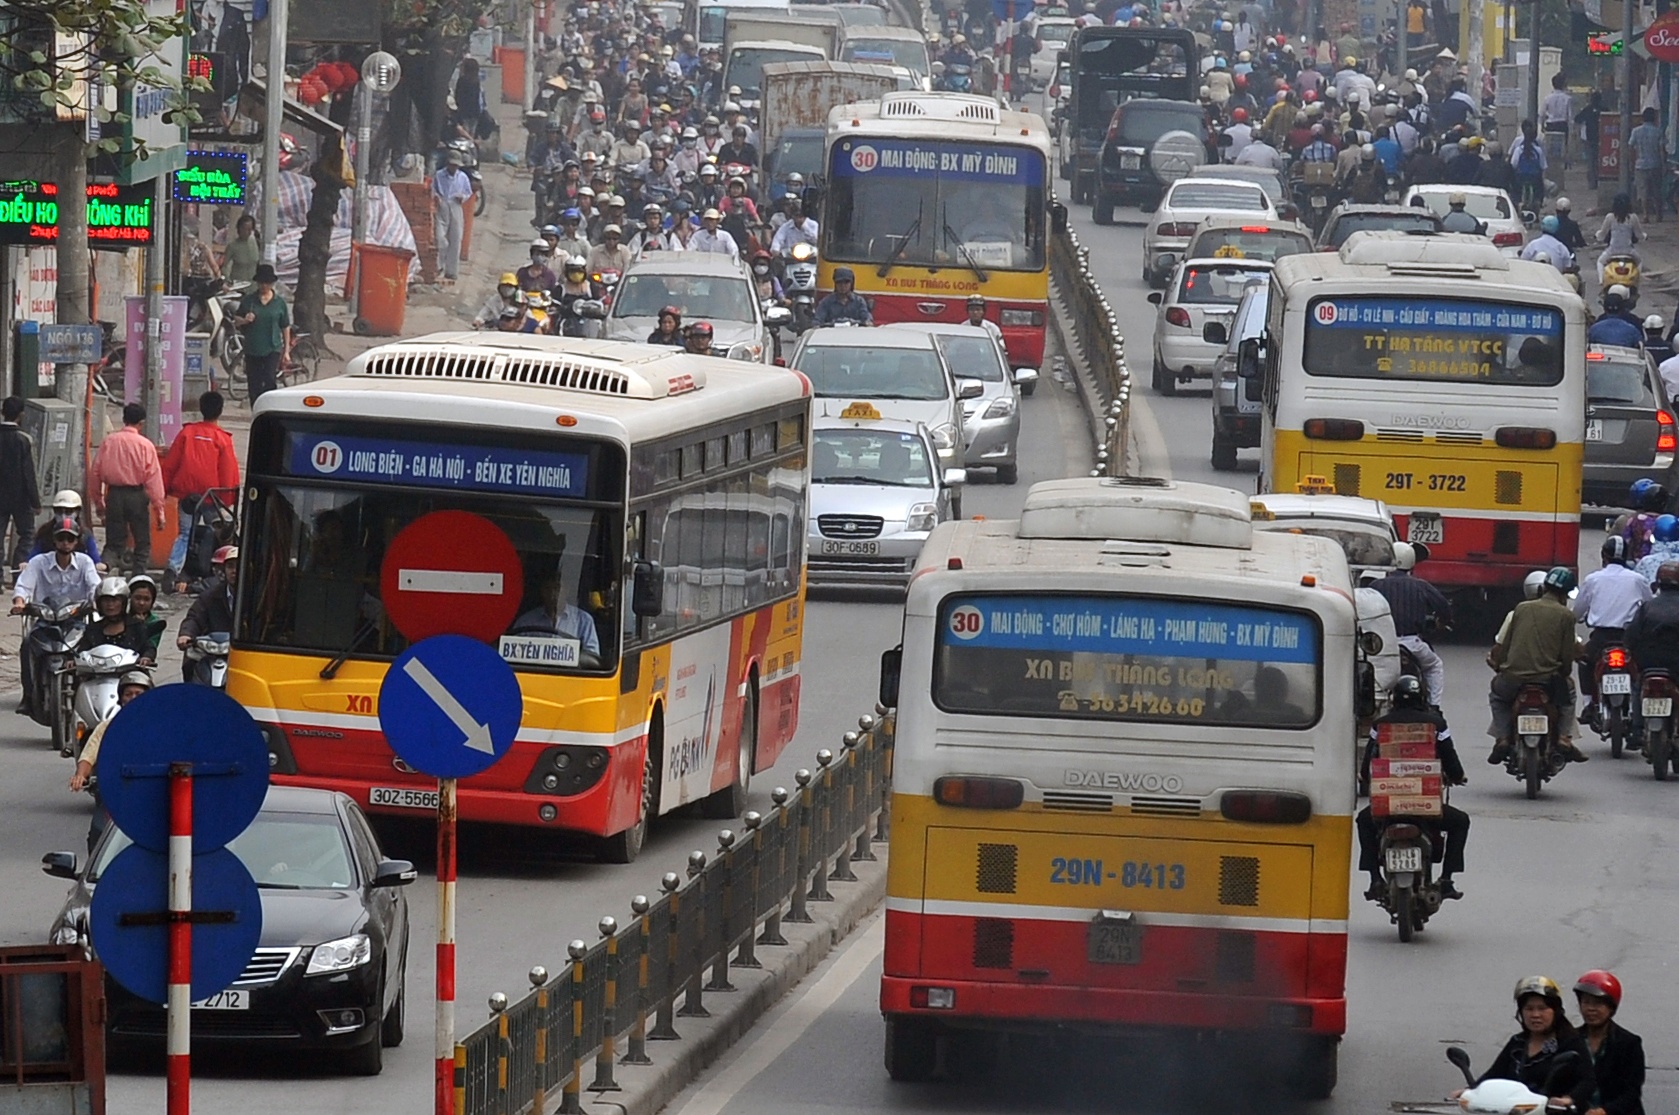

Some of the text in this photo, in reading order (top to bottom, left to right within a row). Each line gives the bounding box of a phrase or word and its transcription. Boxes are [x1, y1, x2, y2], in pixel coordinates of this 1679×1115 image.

[855, 152, 875, 168] 30
[881, 150, 902, 168] MAI
[941, 153, 958, 171] BX
[962, 151, 982, 173] MỸ
[985, 153, 1017, 175] ĐÌNH
[1320, 306, 1334, 320] 09
[1460, 340, 1502, 355] VTCC
[1391, 414, 1471, 429] DAEWOO
[316, 446, 337, 467] 01
[348, 450, 376, 472] LONG
[378, 449, 403, 475] BIÊN
[412, 456, 426, 476] GA
[429, 453, 443, 478] HÀ
[446, 455, 464, 484] NỘI
[475, 454, 497, 483] BẾN
[499, 464, 512, 485] XE
[515, 461, 536, 486] YÊN
[538, 463, 570, 489] NGHĨA
[1385, 472, 1413, 490] 29T
[1428, 474, 1466, 491] 3722
[1411, 530, 1439, 542] 3722
[952, 612, 980, 633] 30
[991, 611, 1011, 634] MAI
[1014, 608, 1043, 639] ĐỘNG
[1053, 612, 1075, 640] CHỢ
[1077, 611, 1101, 637] HÔM
[1110, 613, 1138, 639] LÁNG
[1140, 617, 1155, 645] HẠ
[1165, 618, 1196, 646] PHẠM
[1199, 616, 1228, 644] HÙNG
[1236, 623, 1251, 646] BX
[1253, 622, 1271, 647] MỸ
[1272, 622, 1299, 648] ĐÌNH
[503, 641, 574, 661] BX YÊN NGHĨA
[293, 729, 344, 739] DAEWOO
[1064, 769, 1183, 794] DAEWOO
[374, 789, 438, 807] 30Z-5566
[1050, 857, 1103, 886] 29N
[1121, 861, 1185, 890] 8413
